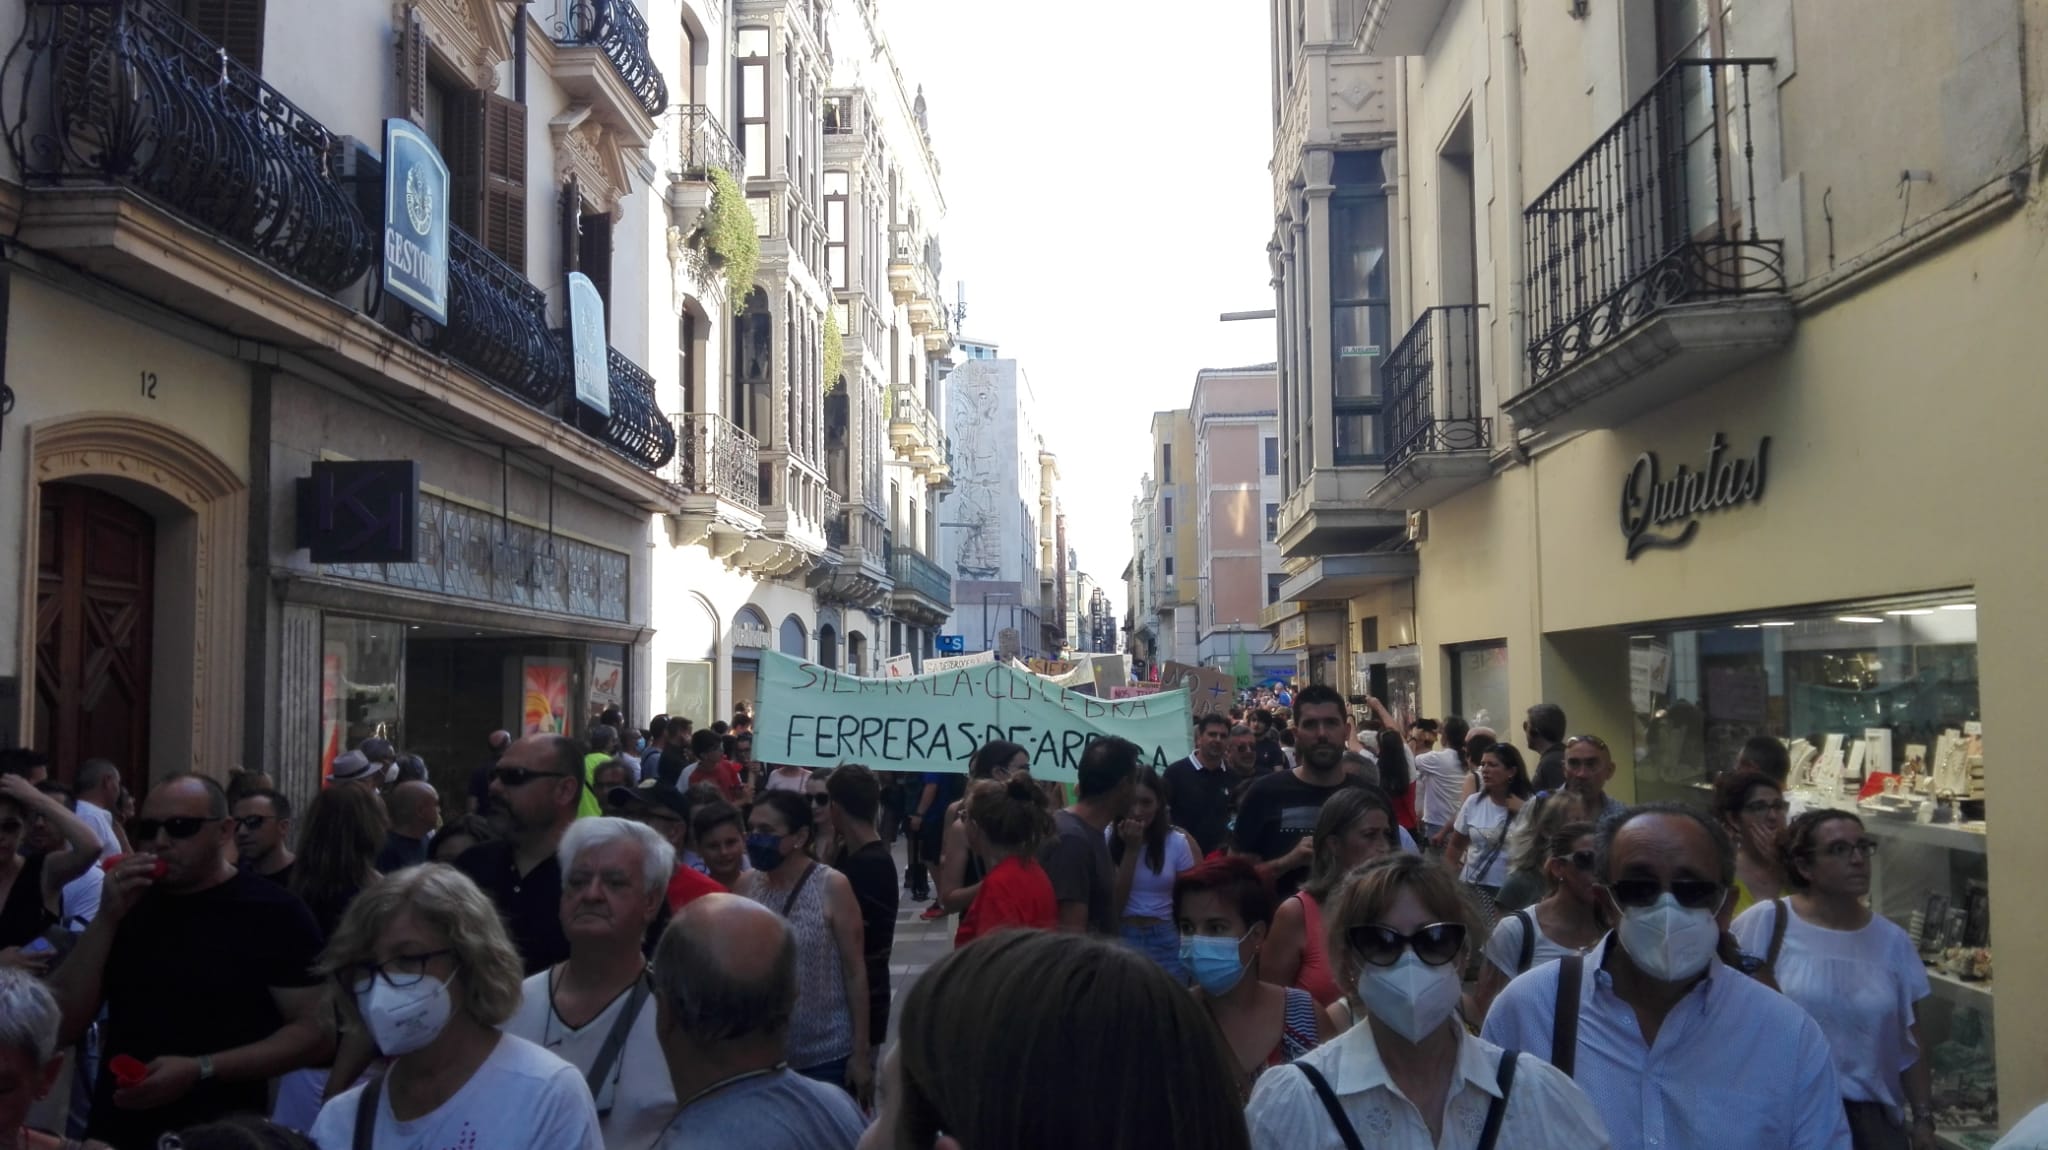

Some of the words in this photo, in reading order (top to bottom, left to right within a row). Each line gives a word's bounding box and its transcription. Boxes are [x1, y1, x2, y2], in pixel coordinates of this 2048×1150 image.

[384, 226, 444, 296] GESTOR
[141, 370, 158, 400] 12
[1620, 432, 1771, 560] Quintas
[1033, 729, 1169, 770] ARA
